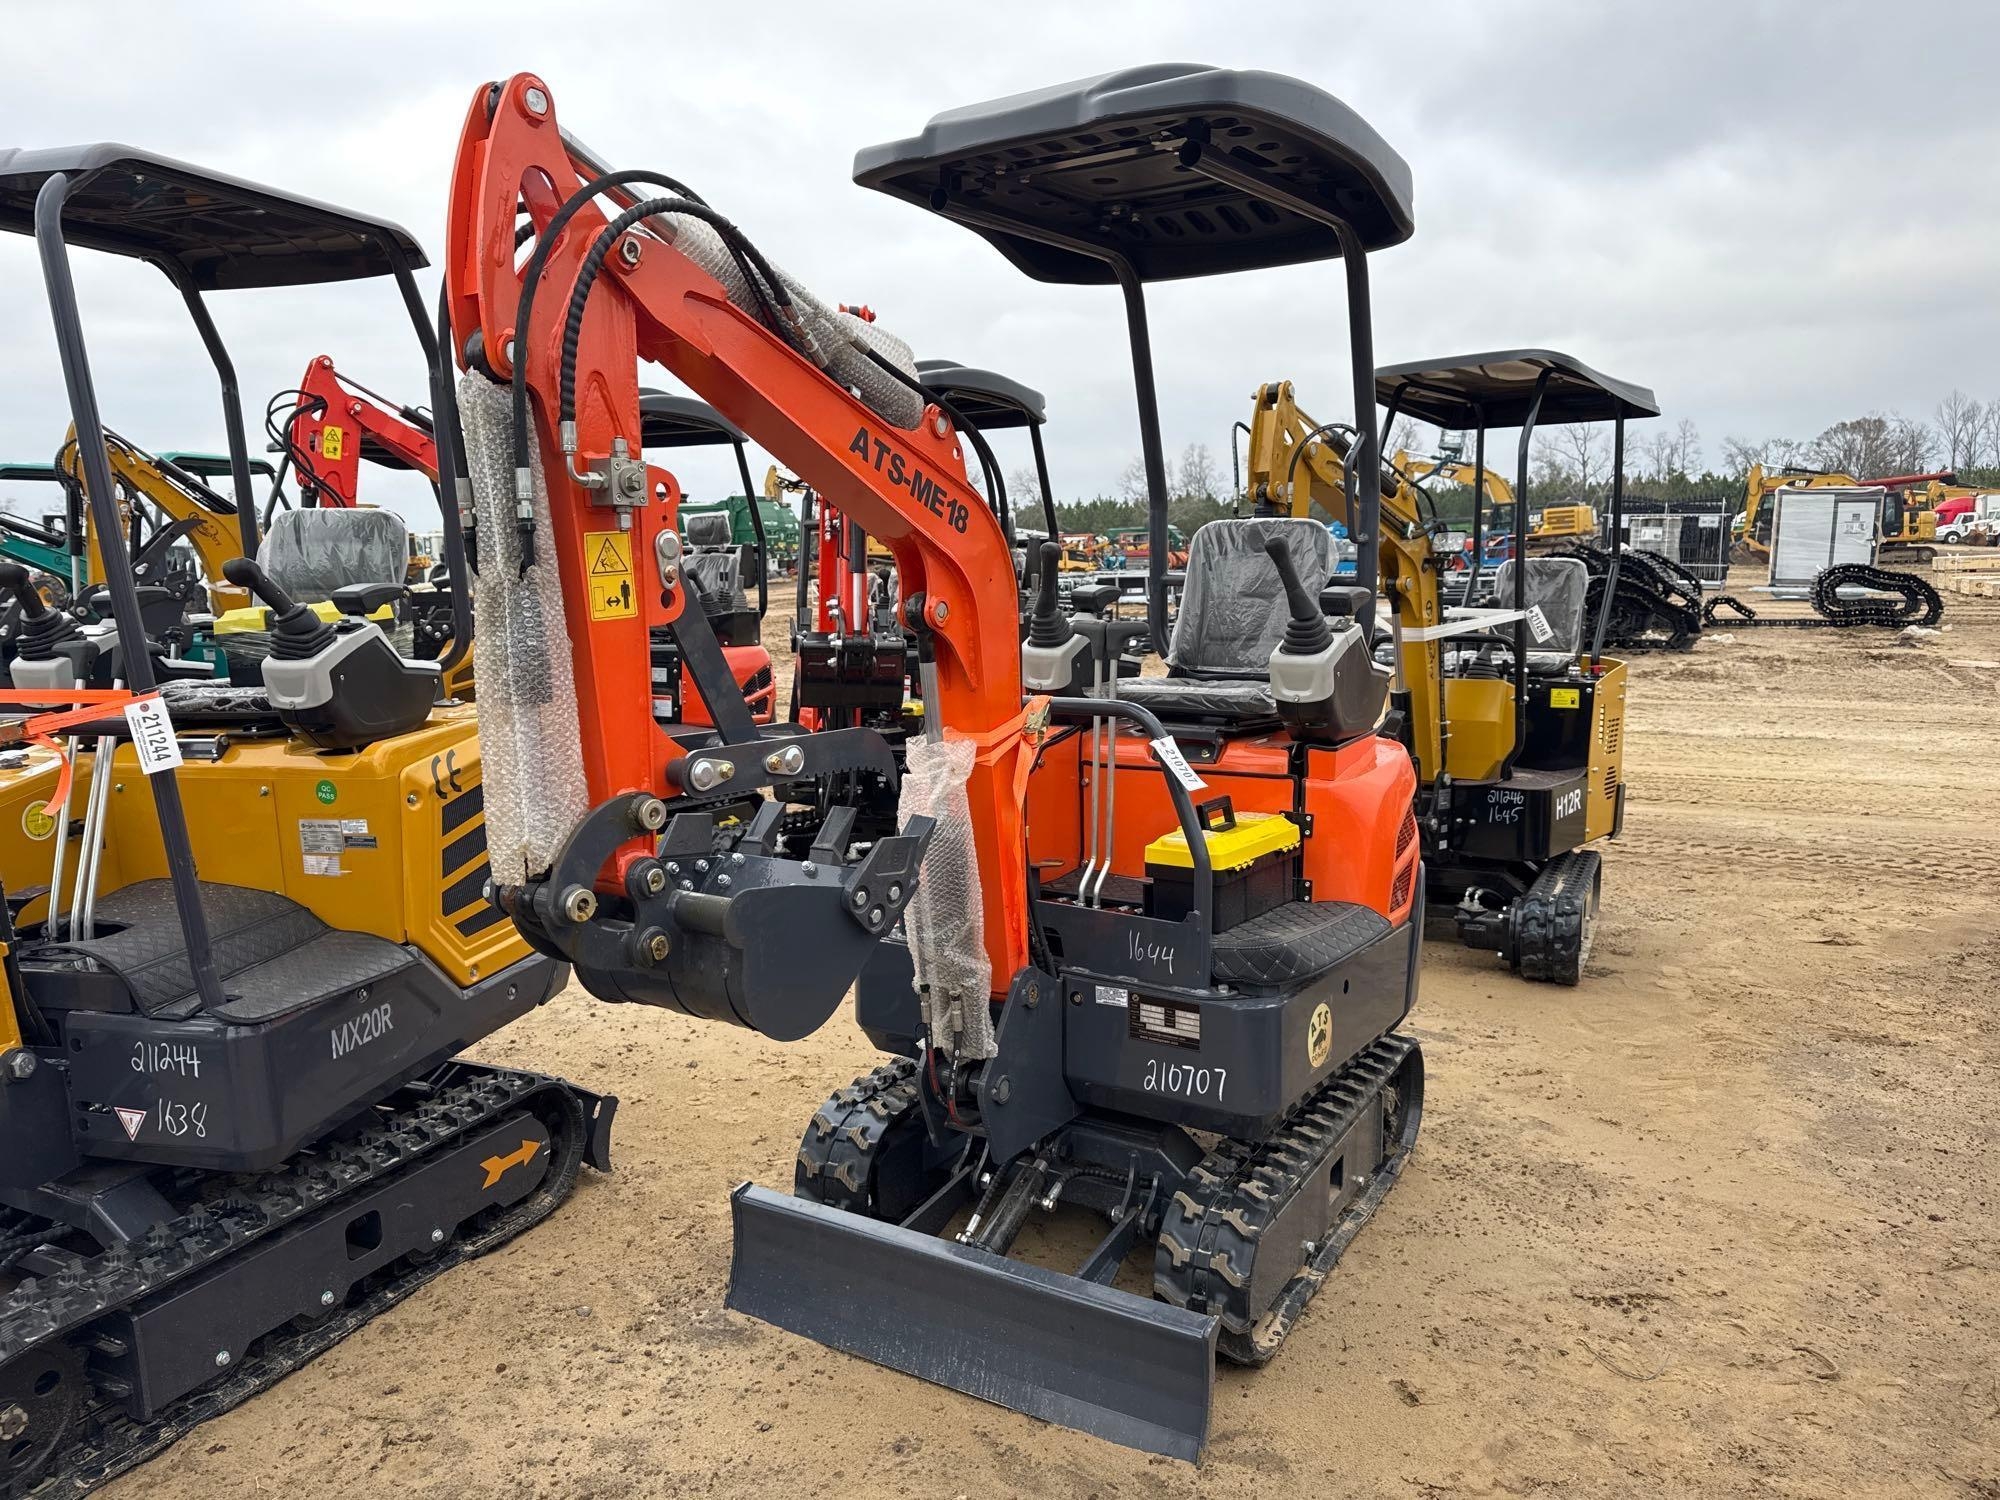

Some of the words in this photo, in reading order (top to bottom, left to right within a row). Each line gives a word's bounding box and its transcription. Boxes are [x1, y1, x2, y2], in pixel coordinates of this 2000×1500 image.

[849, 426, 969, 533] ATS-ME18
[1528, 514, 1542, 522] CAT
[1530, 612, 1549, 637] 211246
[141, 713, 172, 762] 211244
[1165, 748, 1199, 783] 210707
[318, 792, 335, 800] PASS
[1487, 790, 1525, 805] 211246
[1556, 788, 1581, 820] H12R
[1488, 805, 1525, 825] 1645
[1128, 929, 1175, 975] 1644
[330, 1002, 394, 1060] MX20R
[1311, 1010, 1329, 1038] ATS
[130, 1041, 201, 1079] 211244
[1143, 1059, 1227, 1102] 210707
[157, 1097, 208, 1138] 1638
